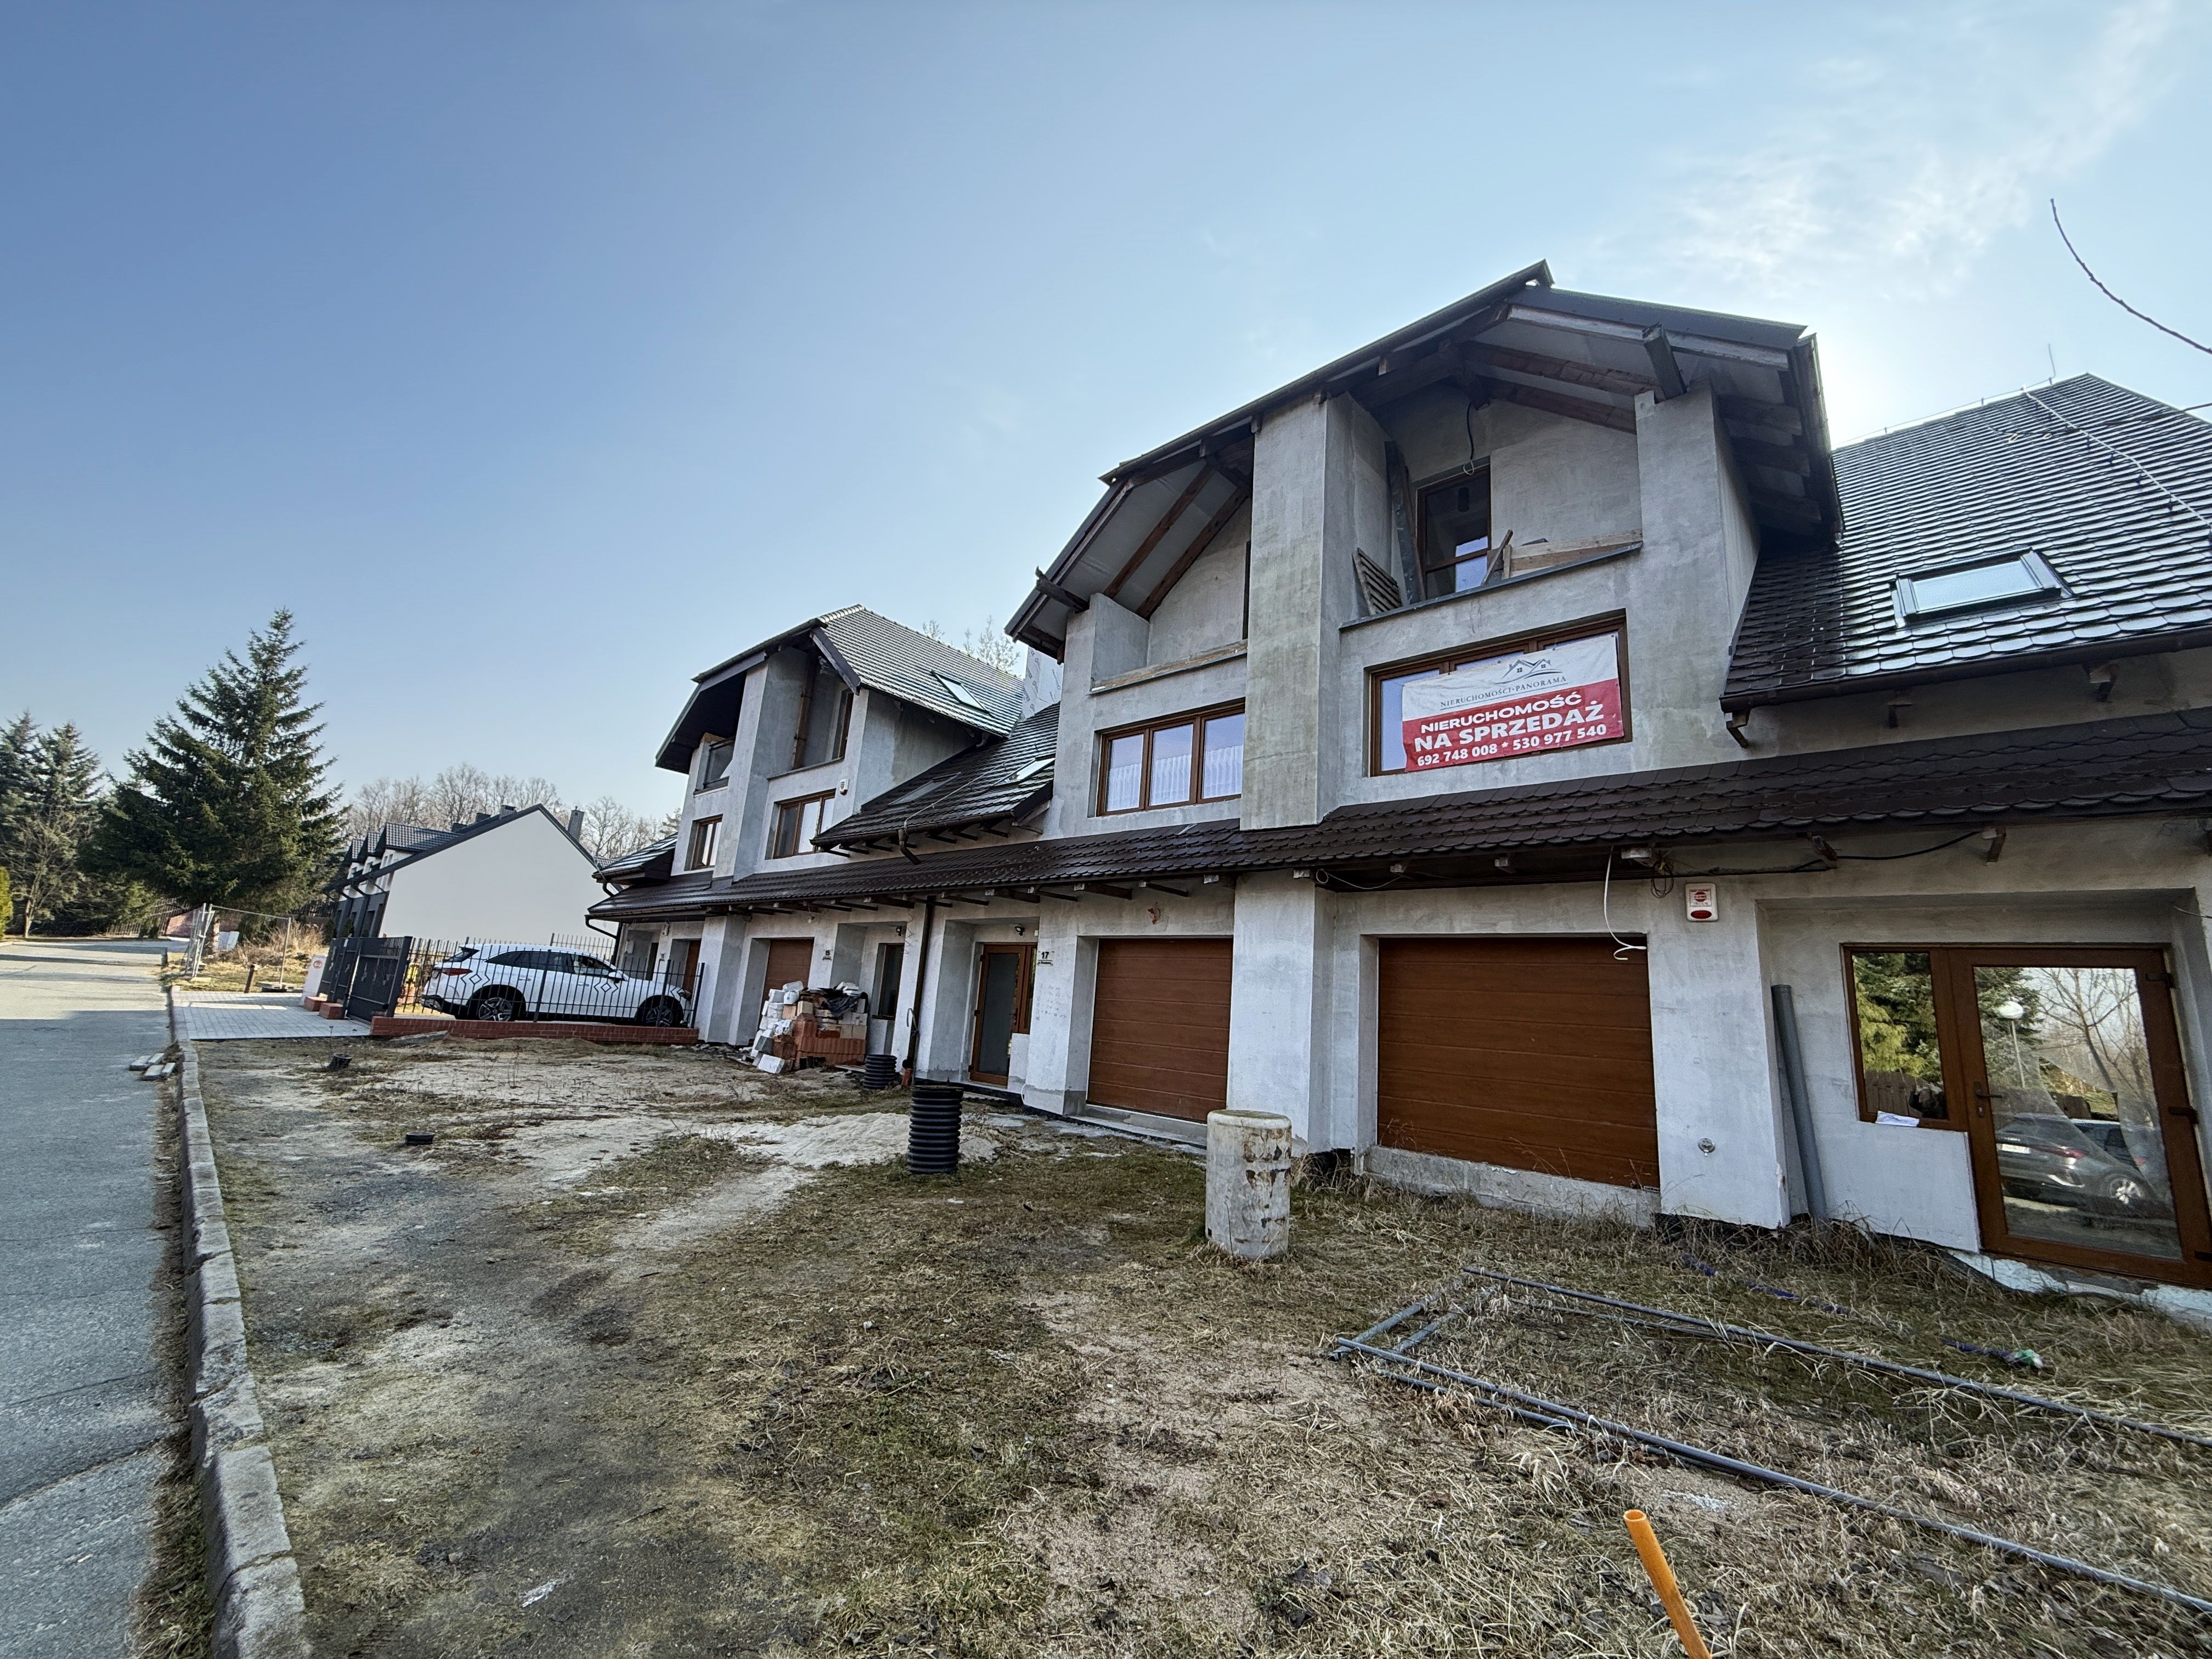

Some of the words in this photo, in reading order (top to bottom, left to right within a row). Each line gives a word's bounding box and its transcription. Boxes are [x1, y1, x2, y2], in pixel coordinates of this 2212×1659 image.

[1414, 733, 1452, 752] NA
[1459, 700, 1604, 744] SPRZEDAŻ
[1421, 692, 1582, 733] NIERUCHOMOŚĆ
[1417, 753, 1440, 766] 692
[1443, 748, 1468, 762] 748
[1472, 743, 1498, 757] 008
[1513, 736, 1540, 751] 530
[1544, 730, 1572, 745] 977
[1577, 724, 1607, 740] 540
